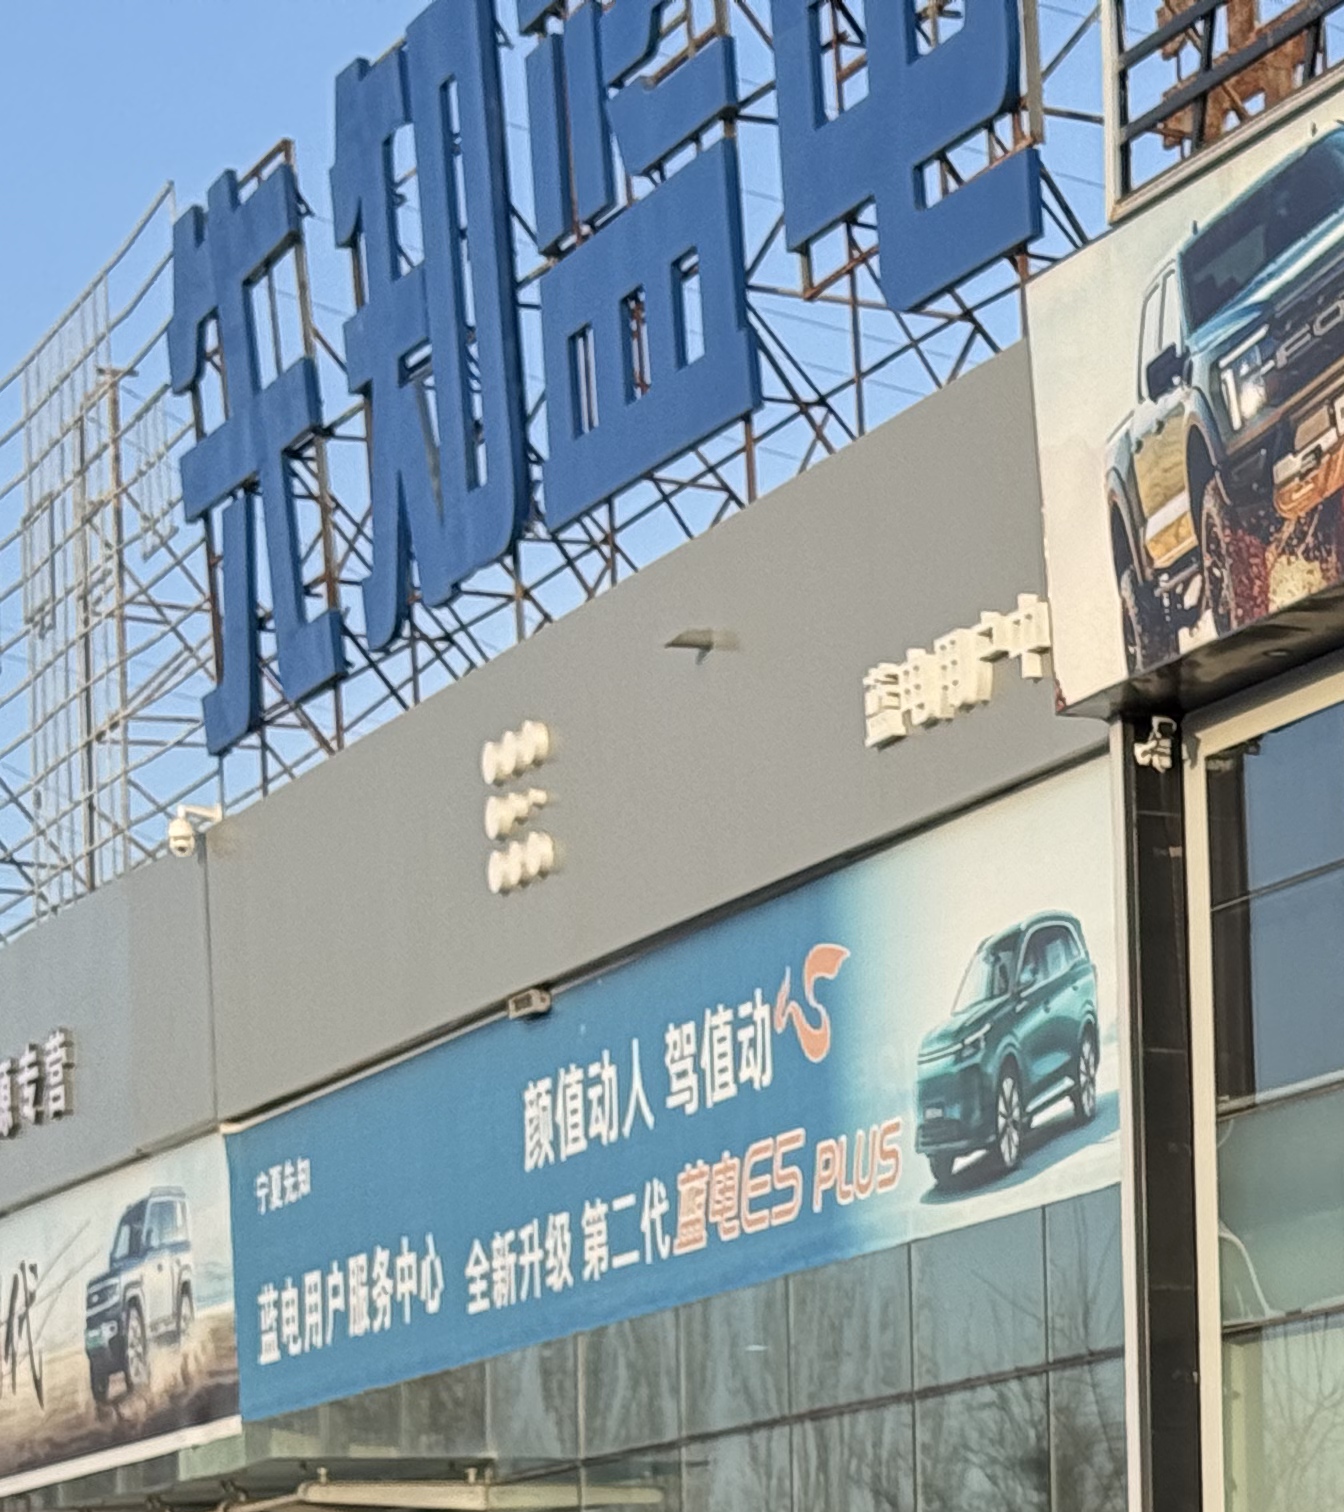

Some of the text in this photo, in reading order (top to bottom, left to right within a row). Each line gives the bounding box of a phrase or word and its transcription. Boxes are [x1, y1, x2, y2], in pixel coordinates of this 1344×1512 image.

[523, 1037, 655, 1173] 颜值动人
[257, 1232, 445, 1367] 蓝电用户服务中心
[465, 1211, 574, 1316] 全新升级
[812, 1115, 902, 1213] PLUS
